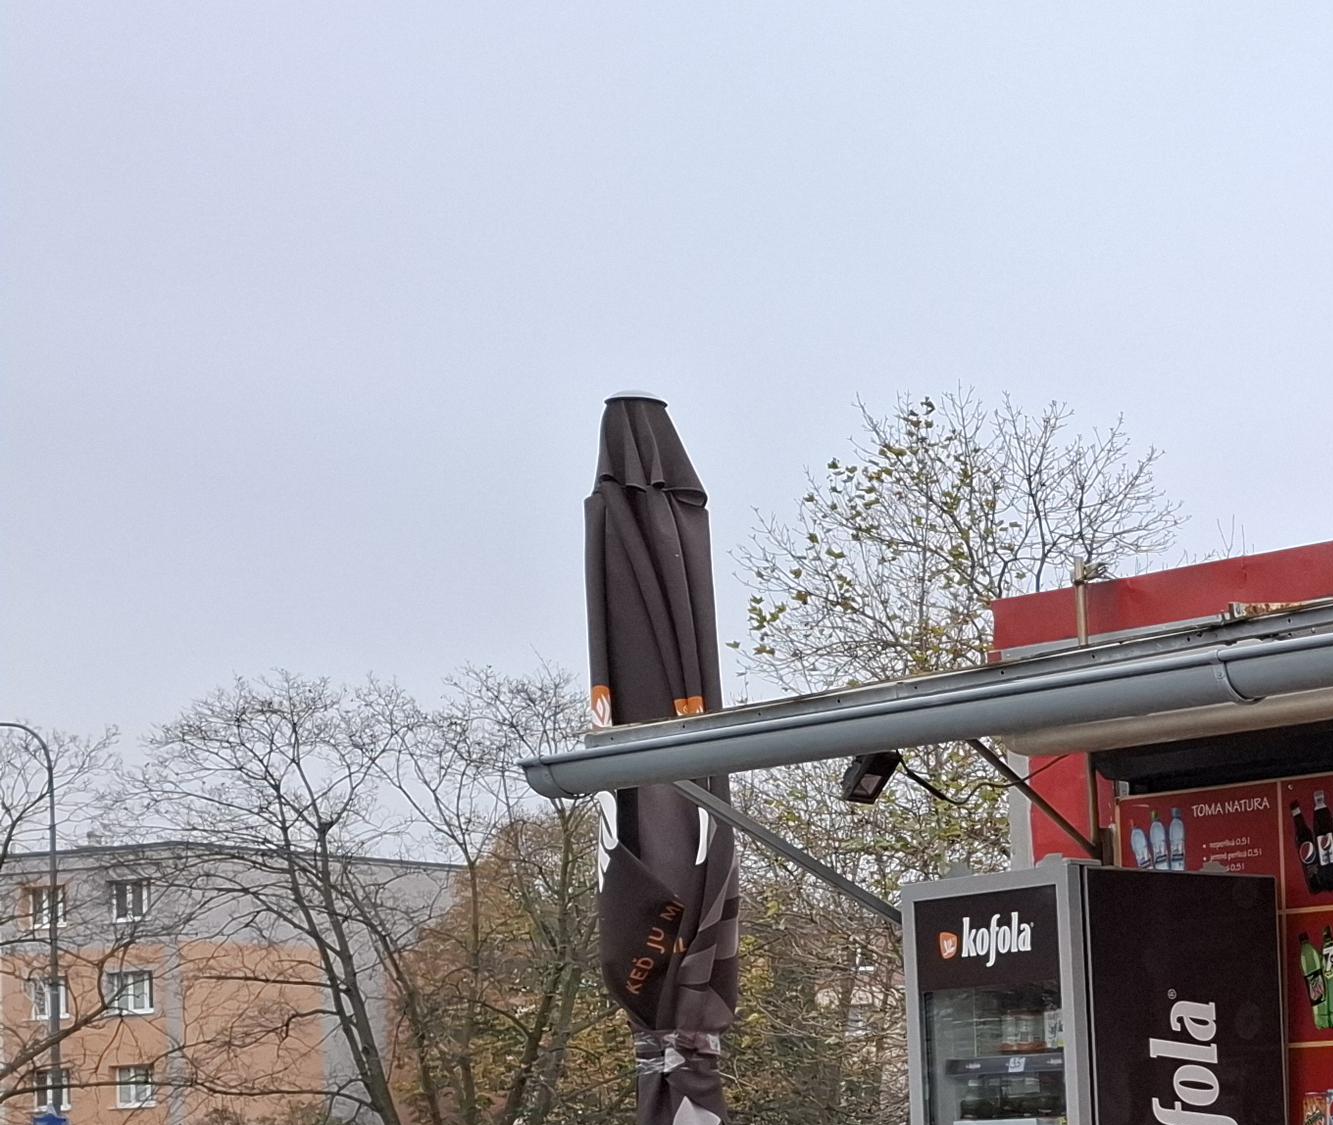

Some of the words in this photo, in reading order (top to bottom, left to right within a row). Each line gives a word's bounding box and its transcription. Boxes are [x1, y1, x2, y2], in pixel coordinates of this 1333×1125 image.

[1192, 803, 1224, 818] TOMA
[1225, 796, 1270, 813] NATURA
[646, 926, 665, 954] JU
[961, 911, 1032, 967] kofola
[625, 956, 655, 994] KEĎ
